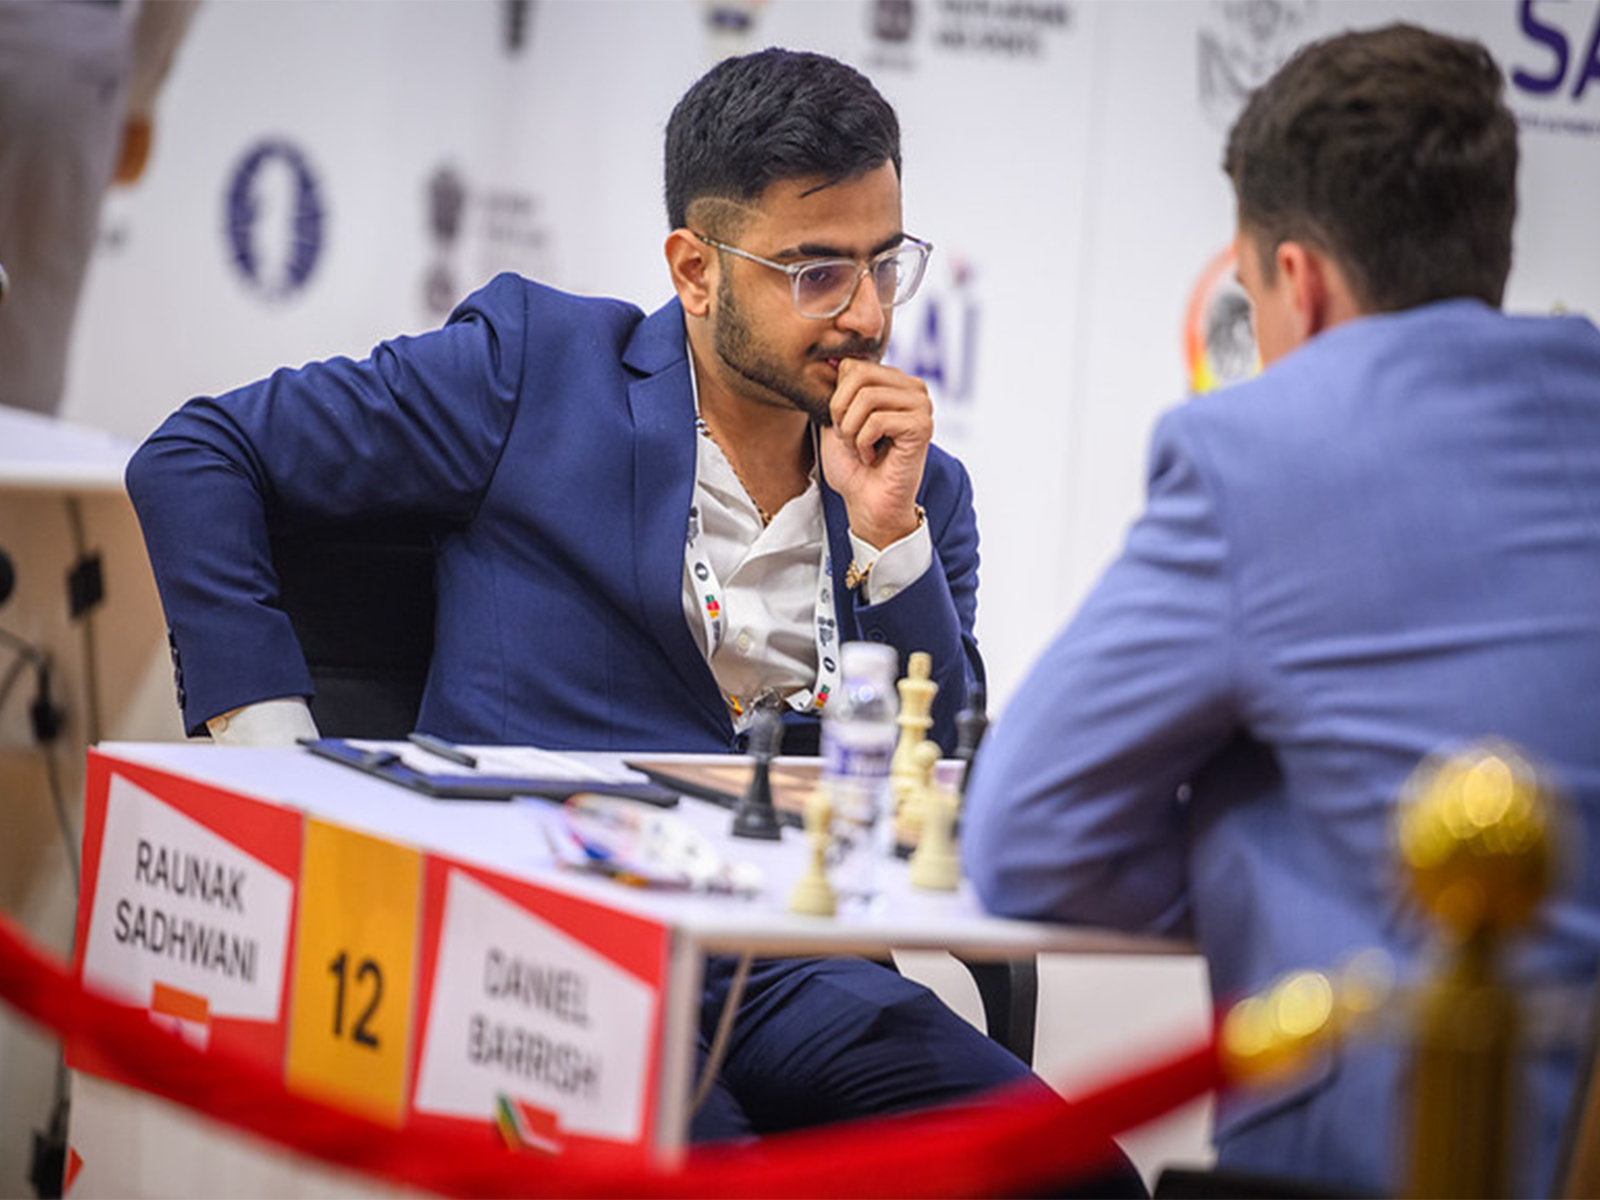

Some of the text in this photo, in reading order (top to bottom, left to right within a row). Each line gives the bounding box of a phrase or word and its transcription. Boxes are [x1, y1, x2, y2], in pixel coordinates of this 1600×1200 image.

[136, 839, 246, 914] RAUNAK
[114, 898, 259, 984] SADHWANI
[327, 951, 384, 1050] 12
[484, 948, 592, 1029] DANIEL
[468, 1013, 602, 1098] BARRISH
